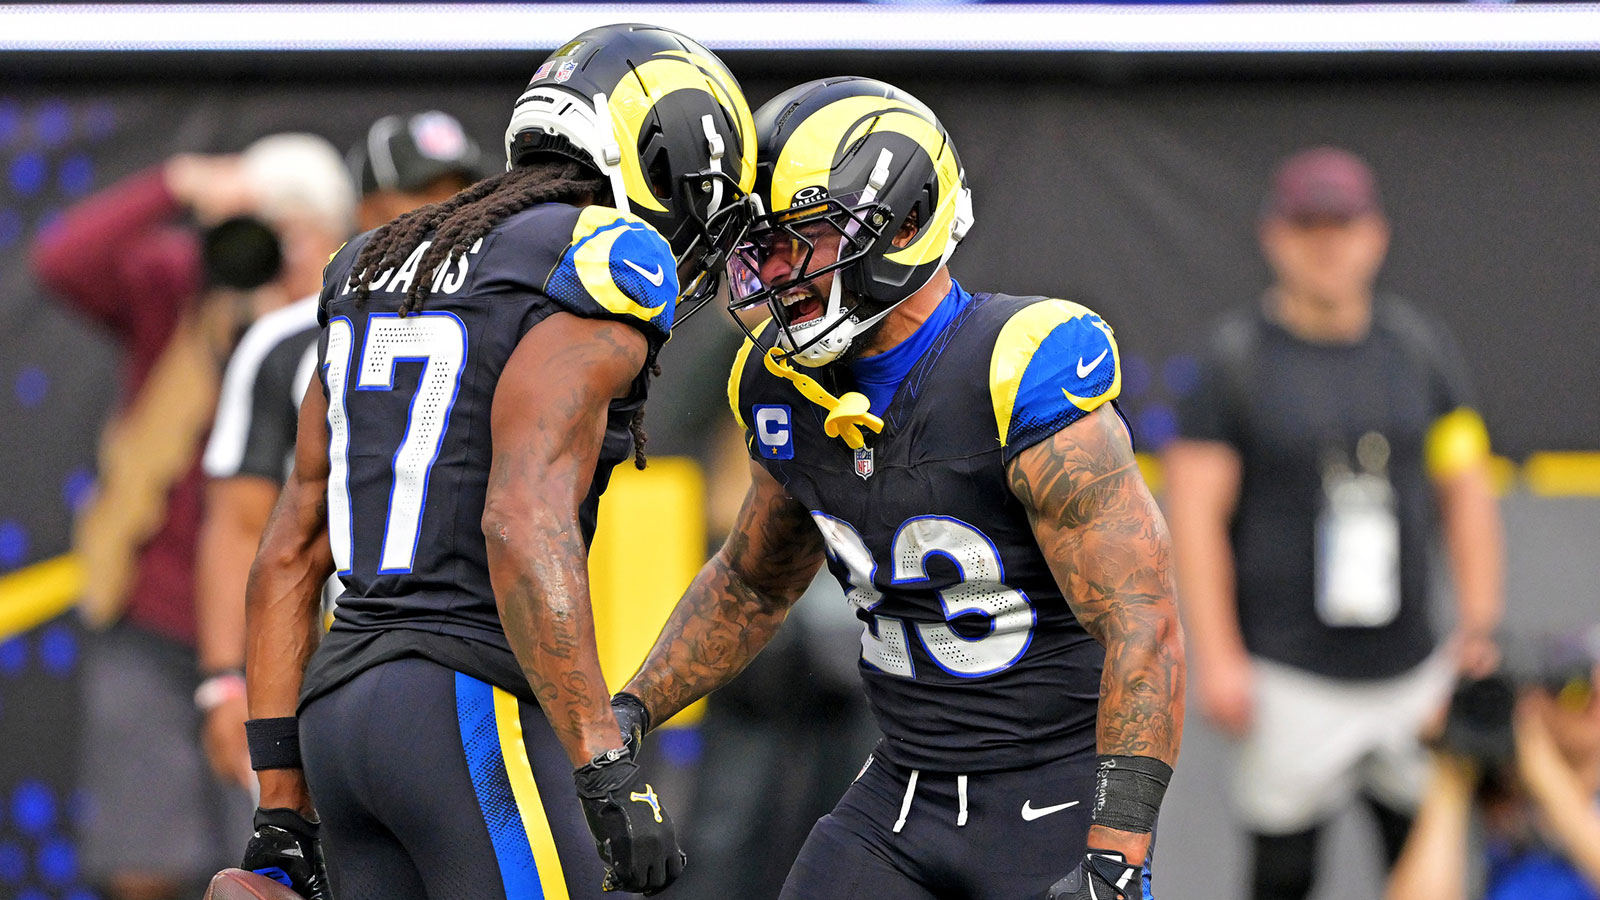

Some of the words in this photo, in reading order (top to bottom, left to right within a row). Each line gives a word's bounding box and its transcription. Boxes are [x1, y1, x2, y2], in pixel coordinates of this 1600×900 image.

[792, 193, 827, 207] OAKLEY
[322, 311, 468, 575] 17
[757, 408, 789, 446] C
[857, 460, 871, 473] NFL
[810, 510, 1037, 679] 23
